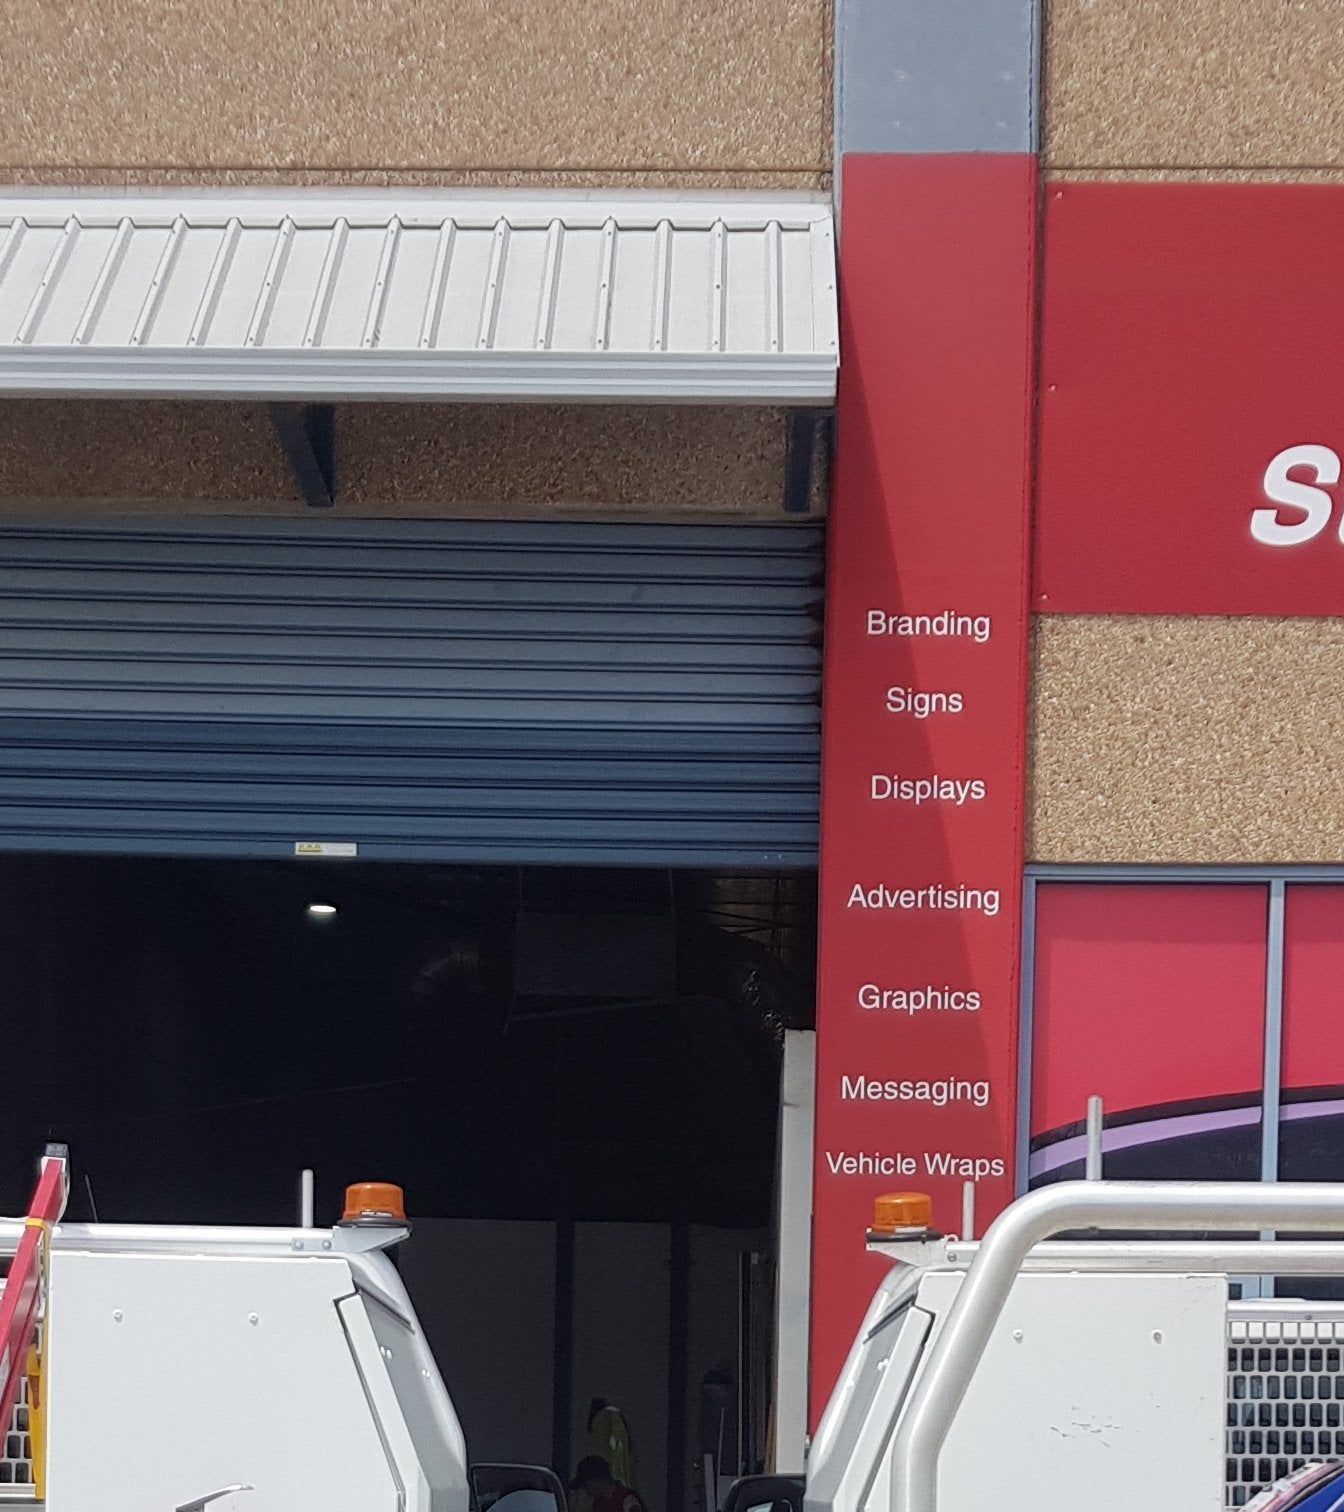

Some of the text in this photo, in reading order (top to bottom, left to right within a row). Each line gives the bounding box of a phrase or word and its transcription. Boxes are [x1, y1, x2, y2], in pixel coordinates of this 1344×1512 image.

[866, 609, 991, 643] Branding
[885, 686, 964, 719] Signs
[870, 774, 986, 805] Displays
[846, 883, 1000, 916] Advertising
[857, 984, 981, 1016] Graphics
[840, 1075, 990, 1107] Messaging
[825, 1152, 1005, 1181] Vehicle Wraps
